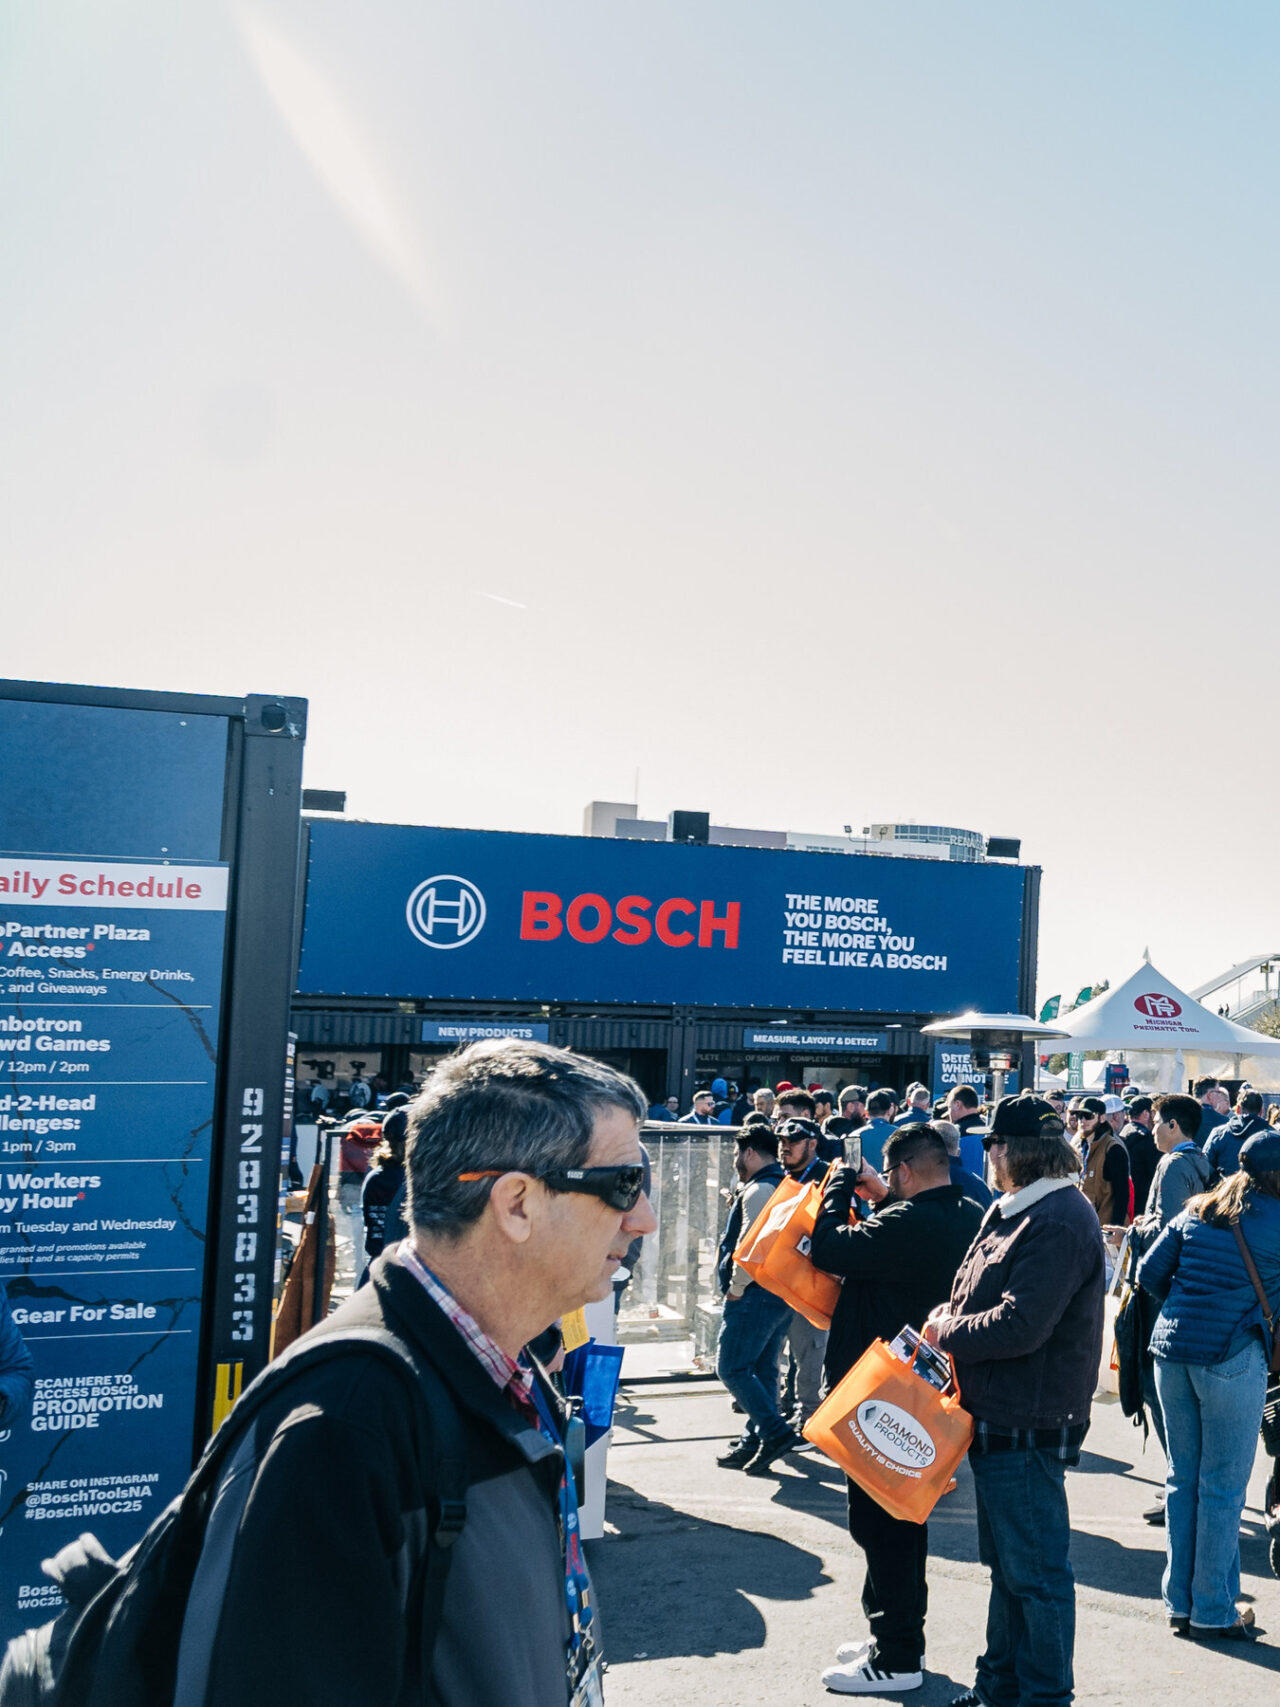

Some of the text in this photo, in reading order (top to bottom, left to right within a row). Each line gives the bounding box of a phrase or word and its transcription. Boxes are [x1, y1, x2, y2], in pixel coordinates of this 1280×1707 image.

[57, 873, 202, 899] Schedule
[785, 893, 879, 914] THE MORE
[519, 891, 741, 949] BOSCH
[784, 912, 893, 935] YOU BOSCH,
[93, 924, 151, 941] Plaza
[783, 930, 915, 951] THE MORE YOU
[782, 948, 948, 971] FEEL LIKE A BOSCH
[48, 967, 99, 980] Snacks,
[102, 968, 147, 982] Energy
[150, 969, 195, 982] Drinks,
[8, 982, 34, 994] and
[37, 982, 107, 996] Giveaways
[438, 1026, 533, 1039] NEW PRODUCTS
[753, 1034, 879, 1047] MEASURE, LAYOUT & DETECT
[35, 1036, 111, 1052] Games
[8, 1061, 46, 1073] 12pm
[59, 1062, 90, 1073] 2pm
[941, 1053, 971, 1064] DETE
[3, 1141, 32, 1153] 1pm
[45, 1141, 76, 1152] 3pm
[7, 1172, 101, 1190] Workers
[15, 1221, 70, 1234] Tuesday
[72, 1220, 98, 1231] and
[101, 1218, 177, 1231] Wednesday
[37, 1244, 55, 1253] and
[56, 1242, 107, 1253] promotions
[108, 1241, 146, 1250] available
[11, 1303, 157, 1325] Gear For Sale
[35, 1374, 133, 1389] SCAN HERE TO
[34, 1385, 139, 1400] ACCESS BOSCH
[32, 1394, 164, 1415] PROMOTION
[31, 1413, 100, 1432] GUIDE
[880, 1412, 934, 1458] DIAMOND
[874, 1423, 928, 1466] PRODUCTS
[26, 1473, 159, 1492] SHARE ON INSTAGRAM
[25, 1485, 152, 1508] @BoschToolsNA
[25, 1500, 143, 1520] #BoschWOC25
[18, 1584, 62, 1598] Bosc
[18, 1596, 63, 1609] WOC25
